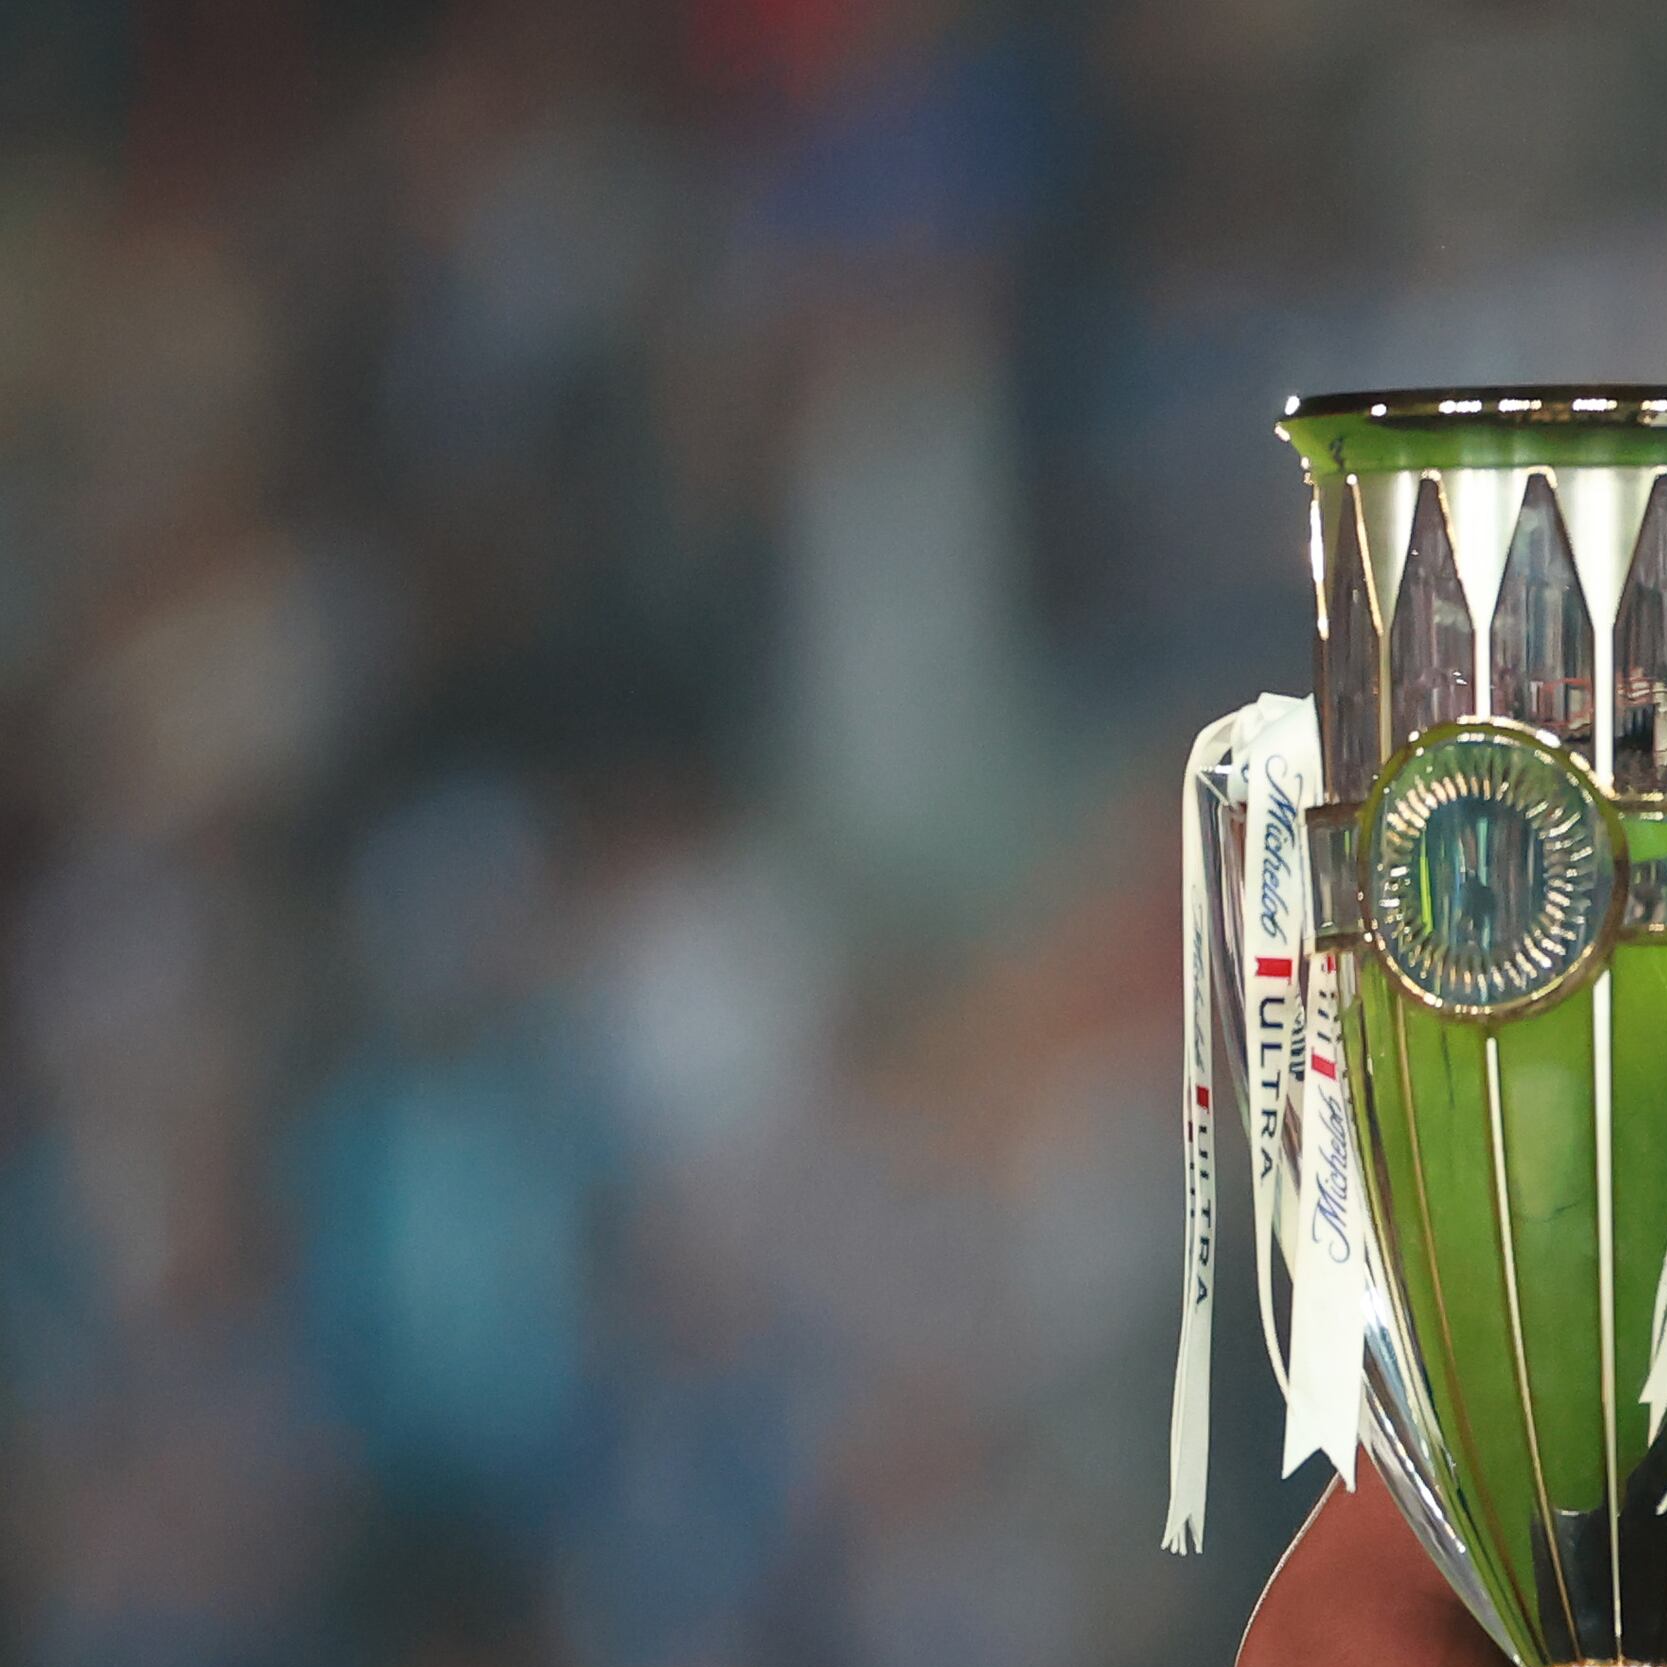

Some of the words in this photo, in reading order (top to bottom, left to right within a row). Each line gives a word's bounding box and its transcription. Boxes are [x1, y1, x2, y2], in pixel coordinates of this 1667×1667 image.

[1263, 754, 1304, 946] Michelob
[1259, 997, 1285, 1183] ULTRA
[1311, 1083, 1351, 1264] Michelob
